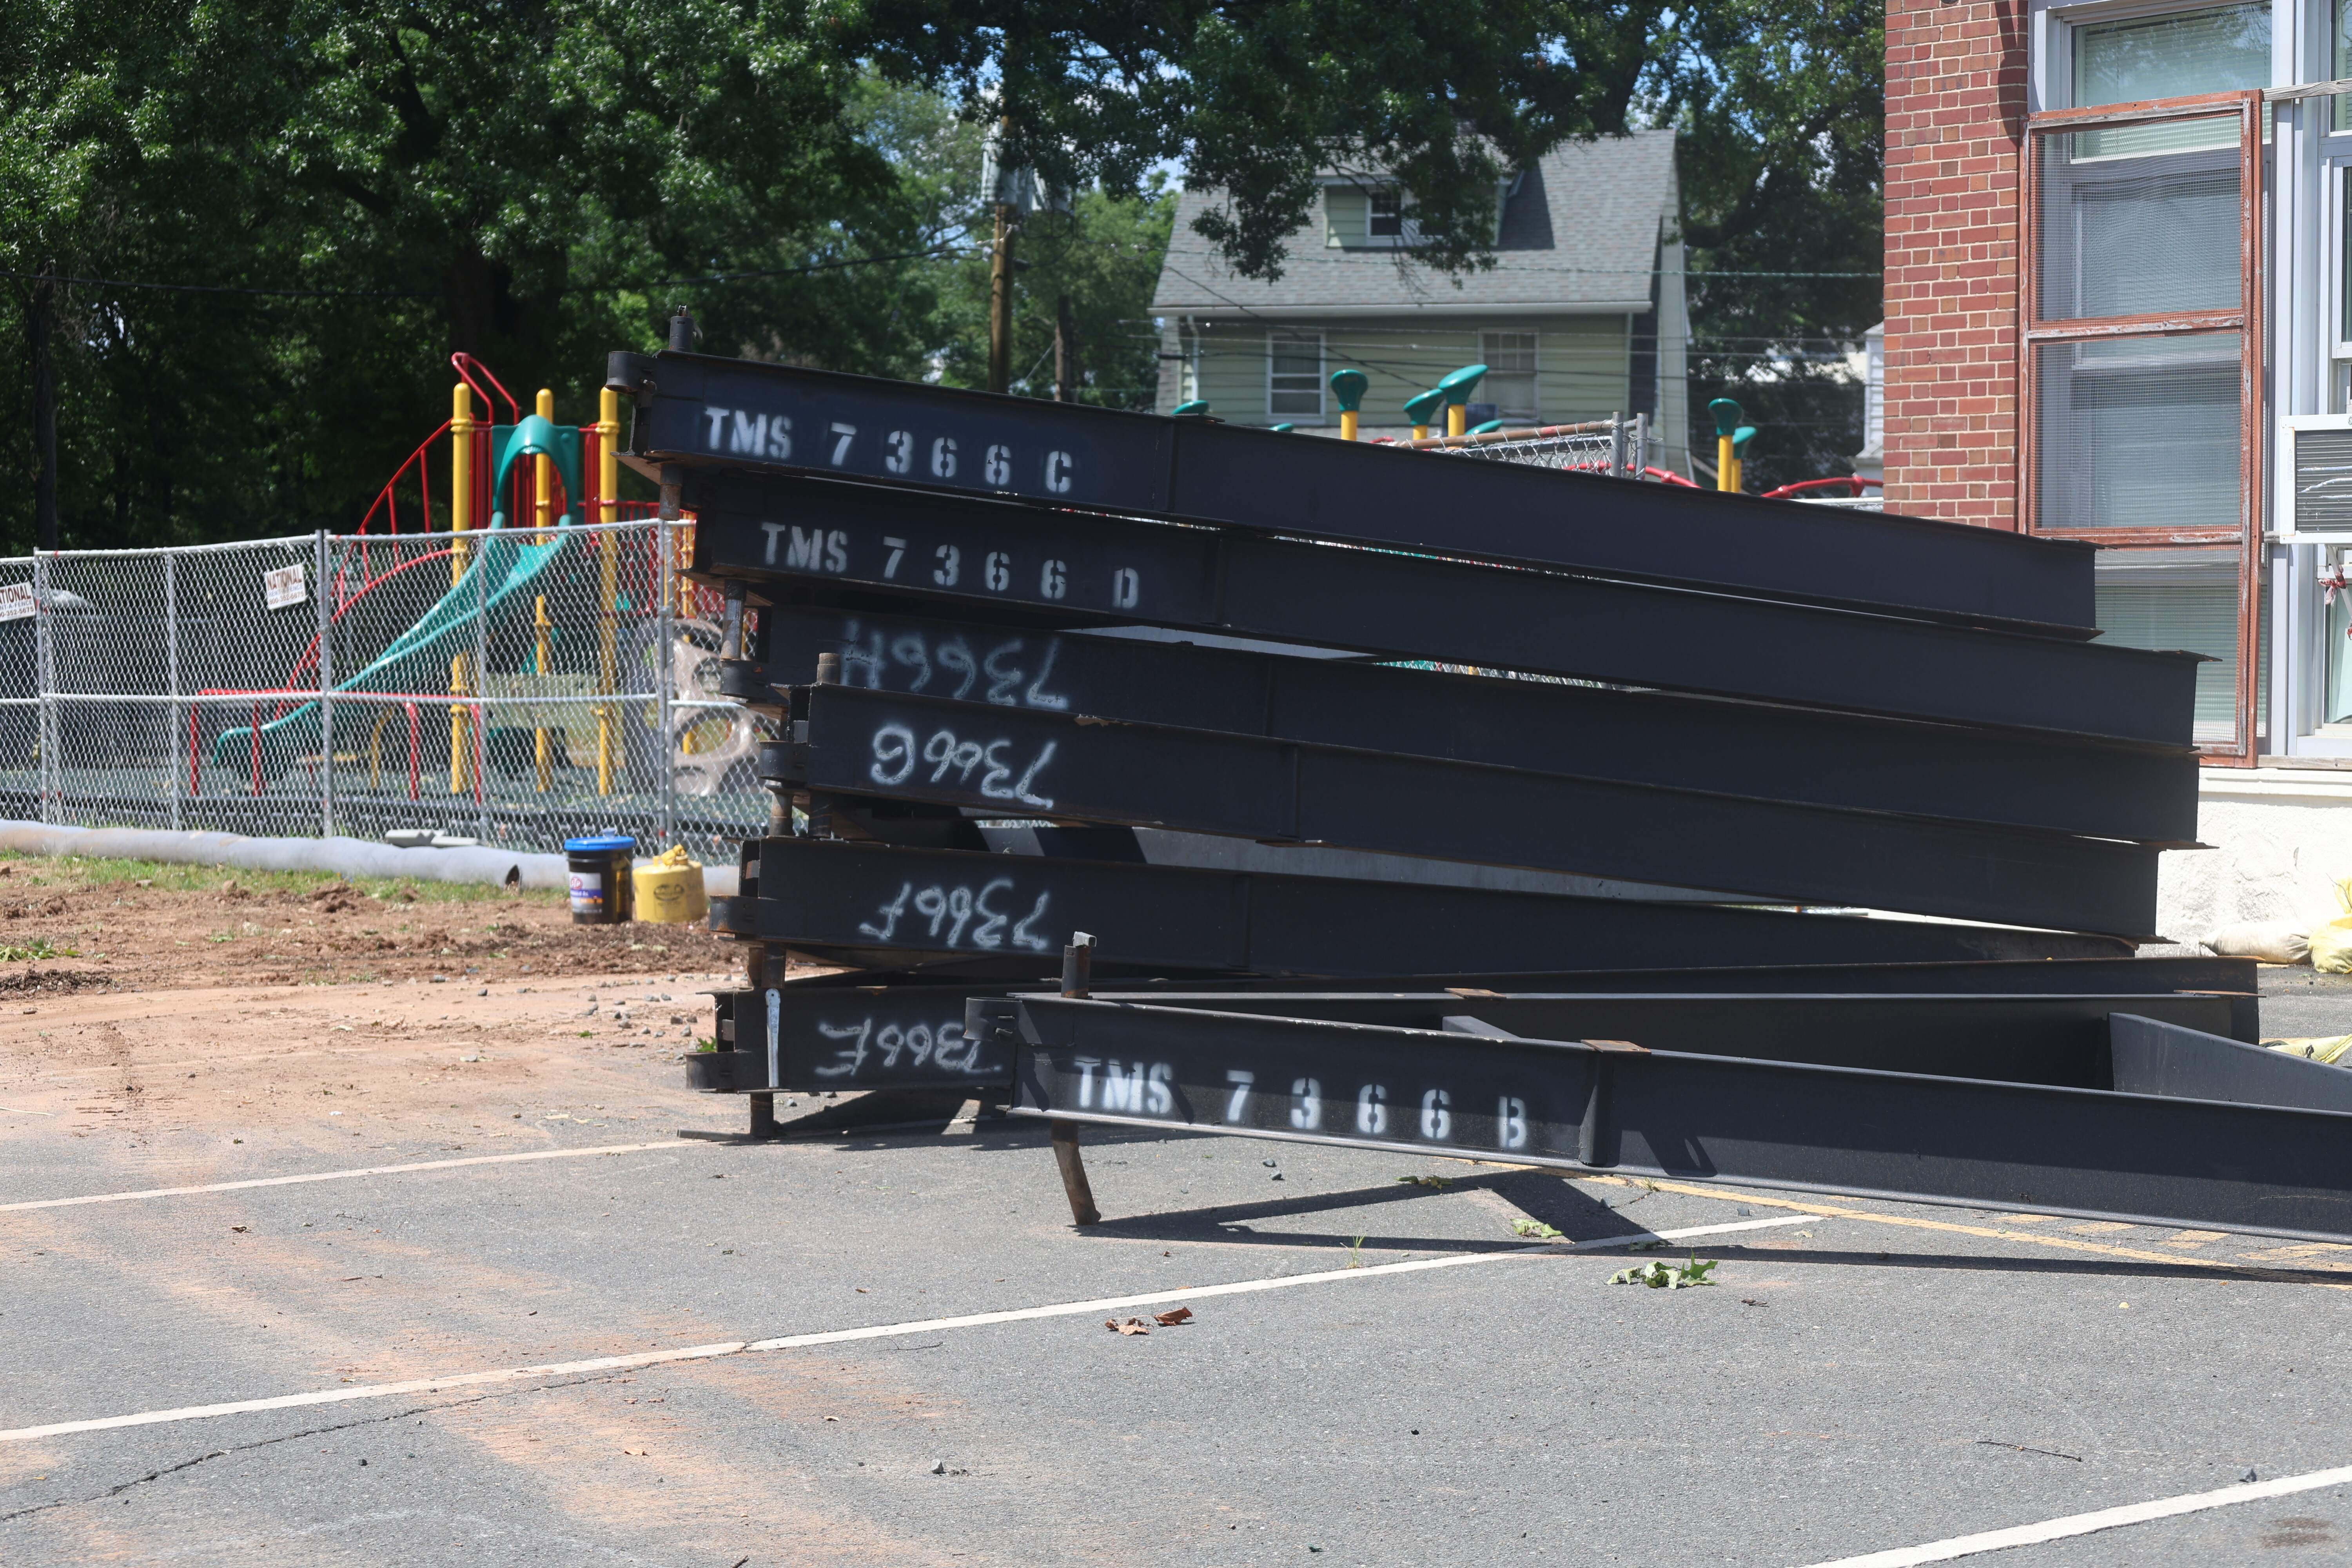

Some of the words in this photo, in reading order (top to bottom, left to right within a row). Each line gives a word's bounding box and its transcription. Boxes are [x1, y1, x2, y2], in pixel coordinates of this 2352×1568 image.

[705, 406, 792, 459] TMS
[761, 522, 848, 573] TMS
[266, 567, 302, 590] NATIONAL
[840, 620, 1068, 708] 7366H
[859, 876, 1050, 951] 7366F
[1074, 1055, 1172, 1115] TMS
